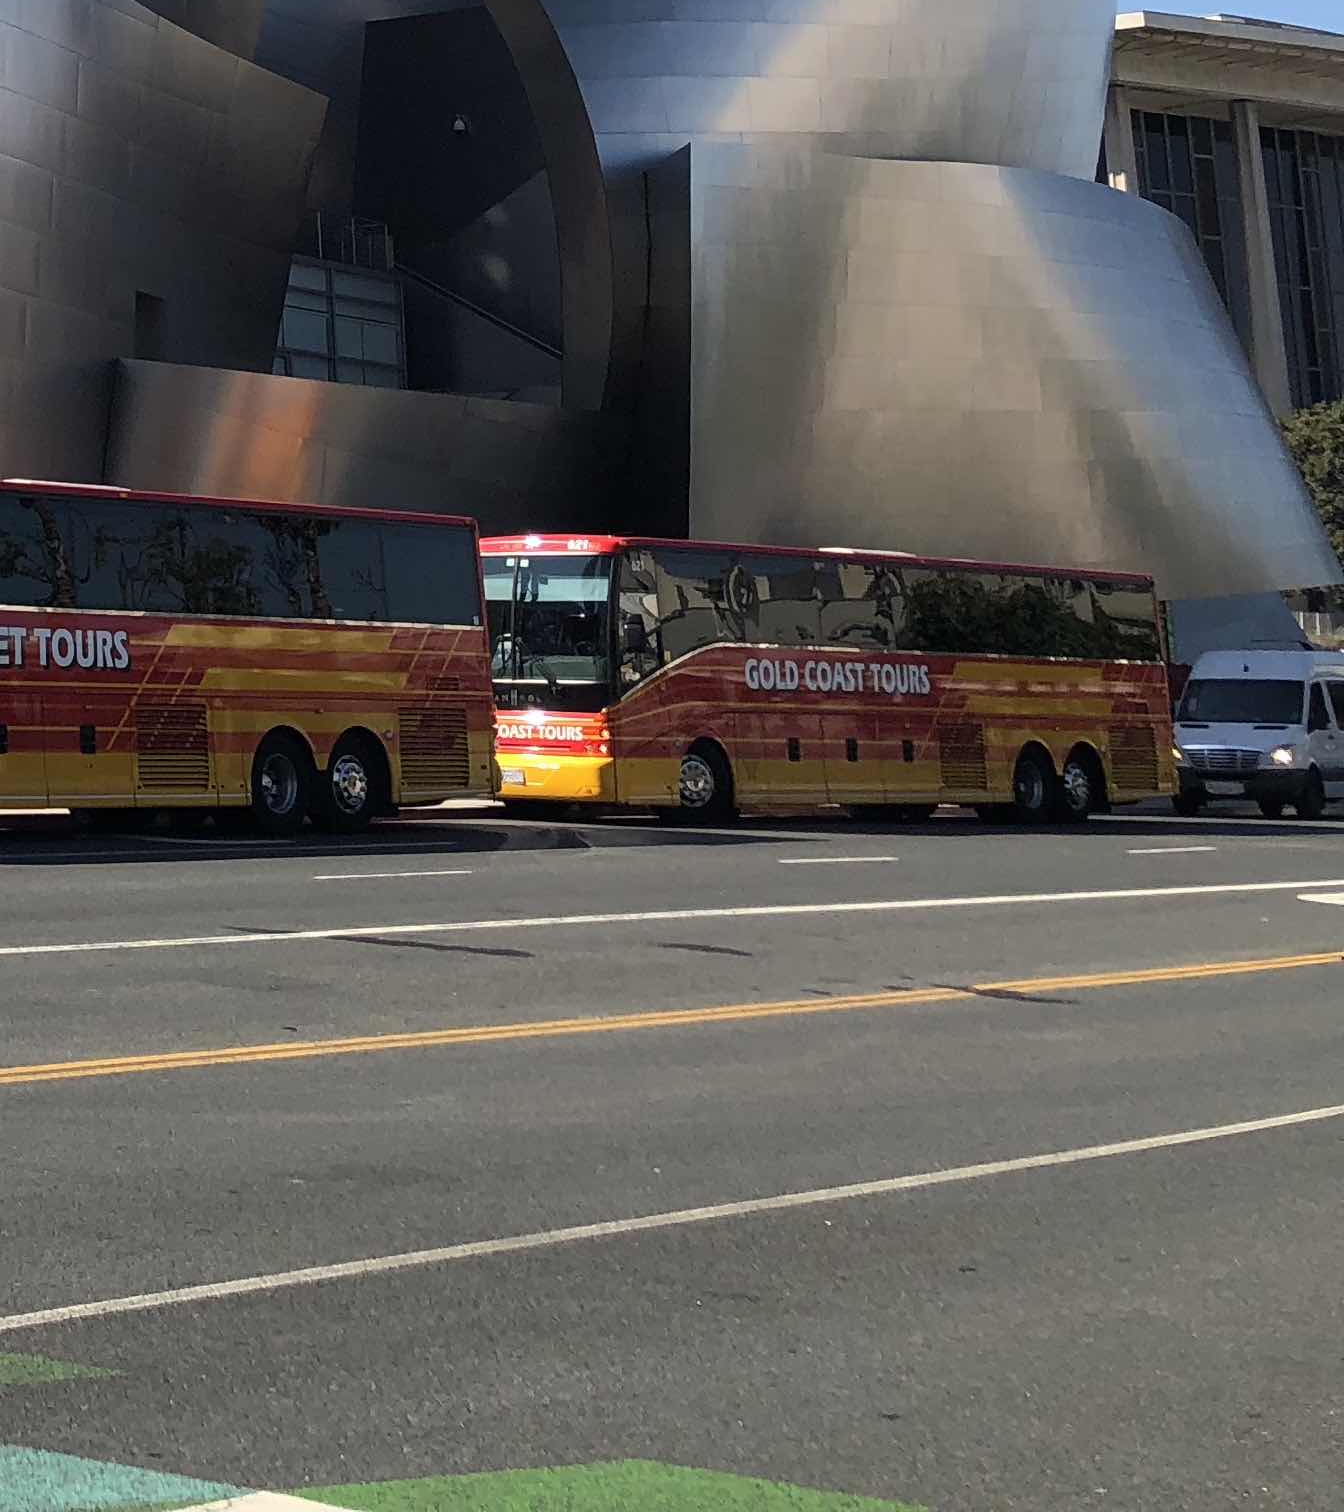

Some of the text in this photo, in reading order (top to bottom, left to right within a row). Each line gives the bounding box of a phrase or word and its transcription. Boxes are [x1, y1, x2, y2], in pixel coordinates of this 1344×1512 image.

[32, 627, 130, 669] TOURS
[745, 658, 931, 695] GOLD COAST TOURS
[492, 724, 584, 741] OAST TOURS
